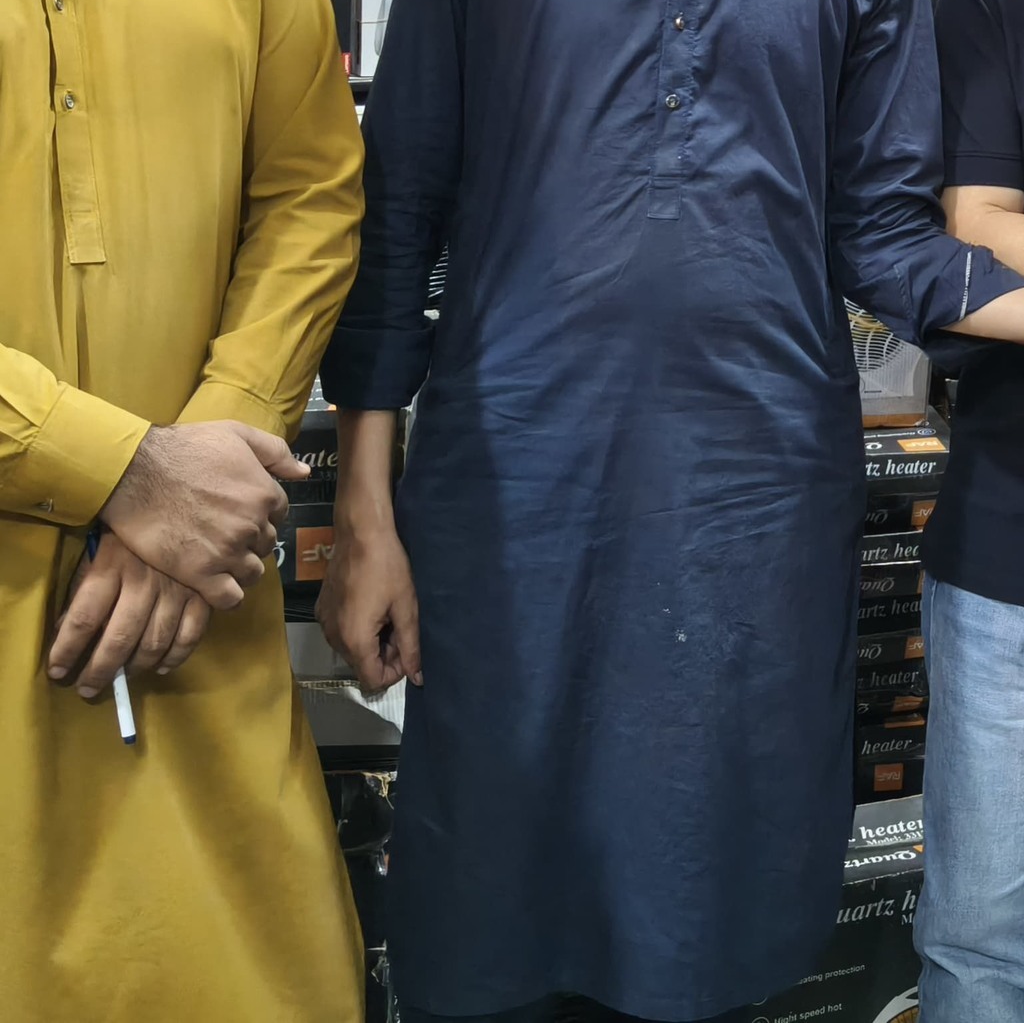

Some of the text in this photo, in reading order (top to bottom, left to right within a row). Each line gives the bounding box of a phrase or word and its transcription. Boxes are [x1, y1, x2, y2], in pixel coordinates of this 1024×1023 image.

[886, 459, 937, 476] heater
[870, 672, 920, 688] heater
[862, 739, 913, 755] heater
[844, 850, 917, 868] Quartz
[800, 964, 866, 984] ating protection
[800, 1003, 843, 1022] speed hot
